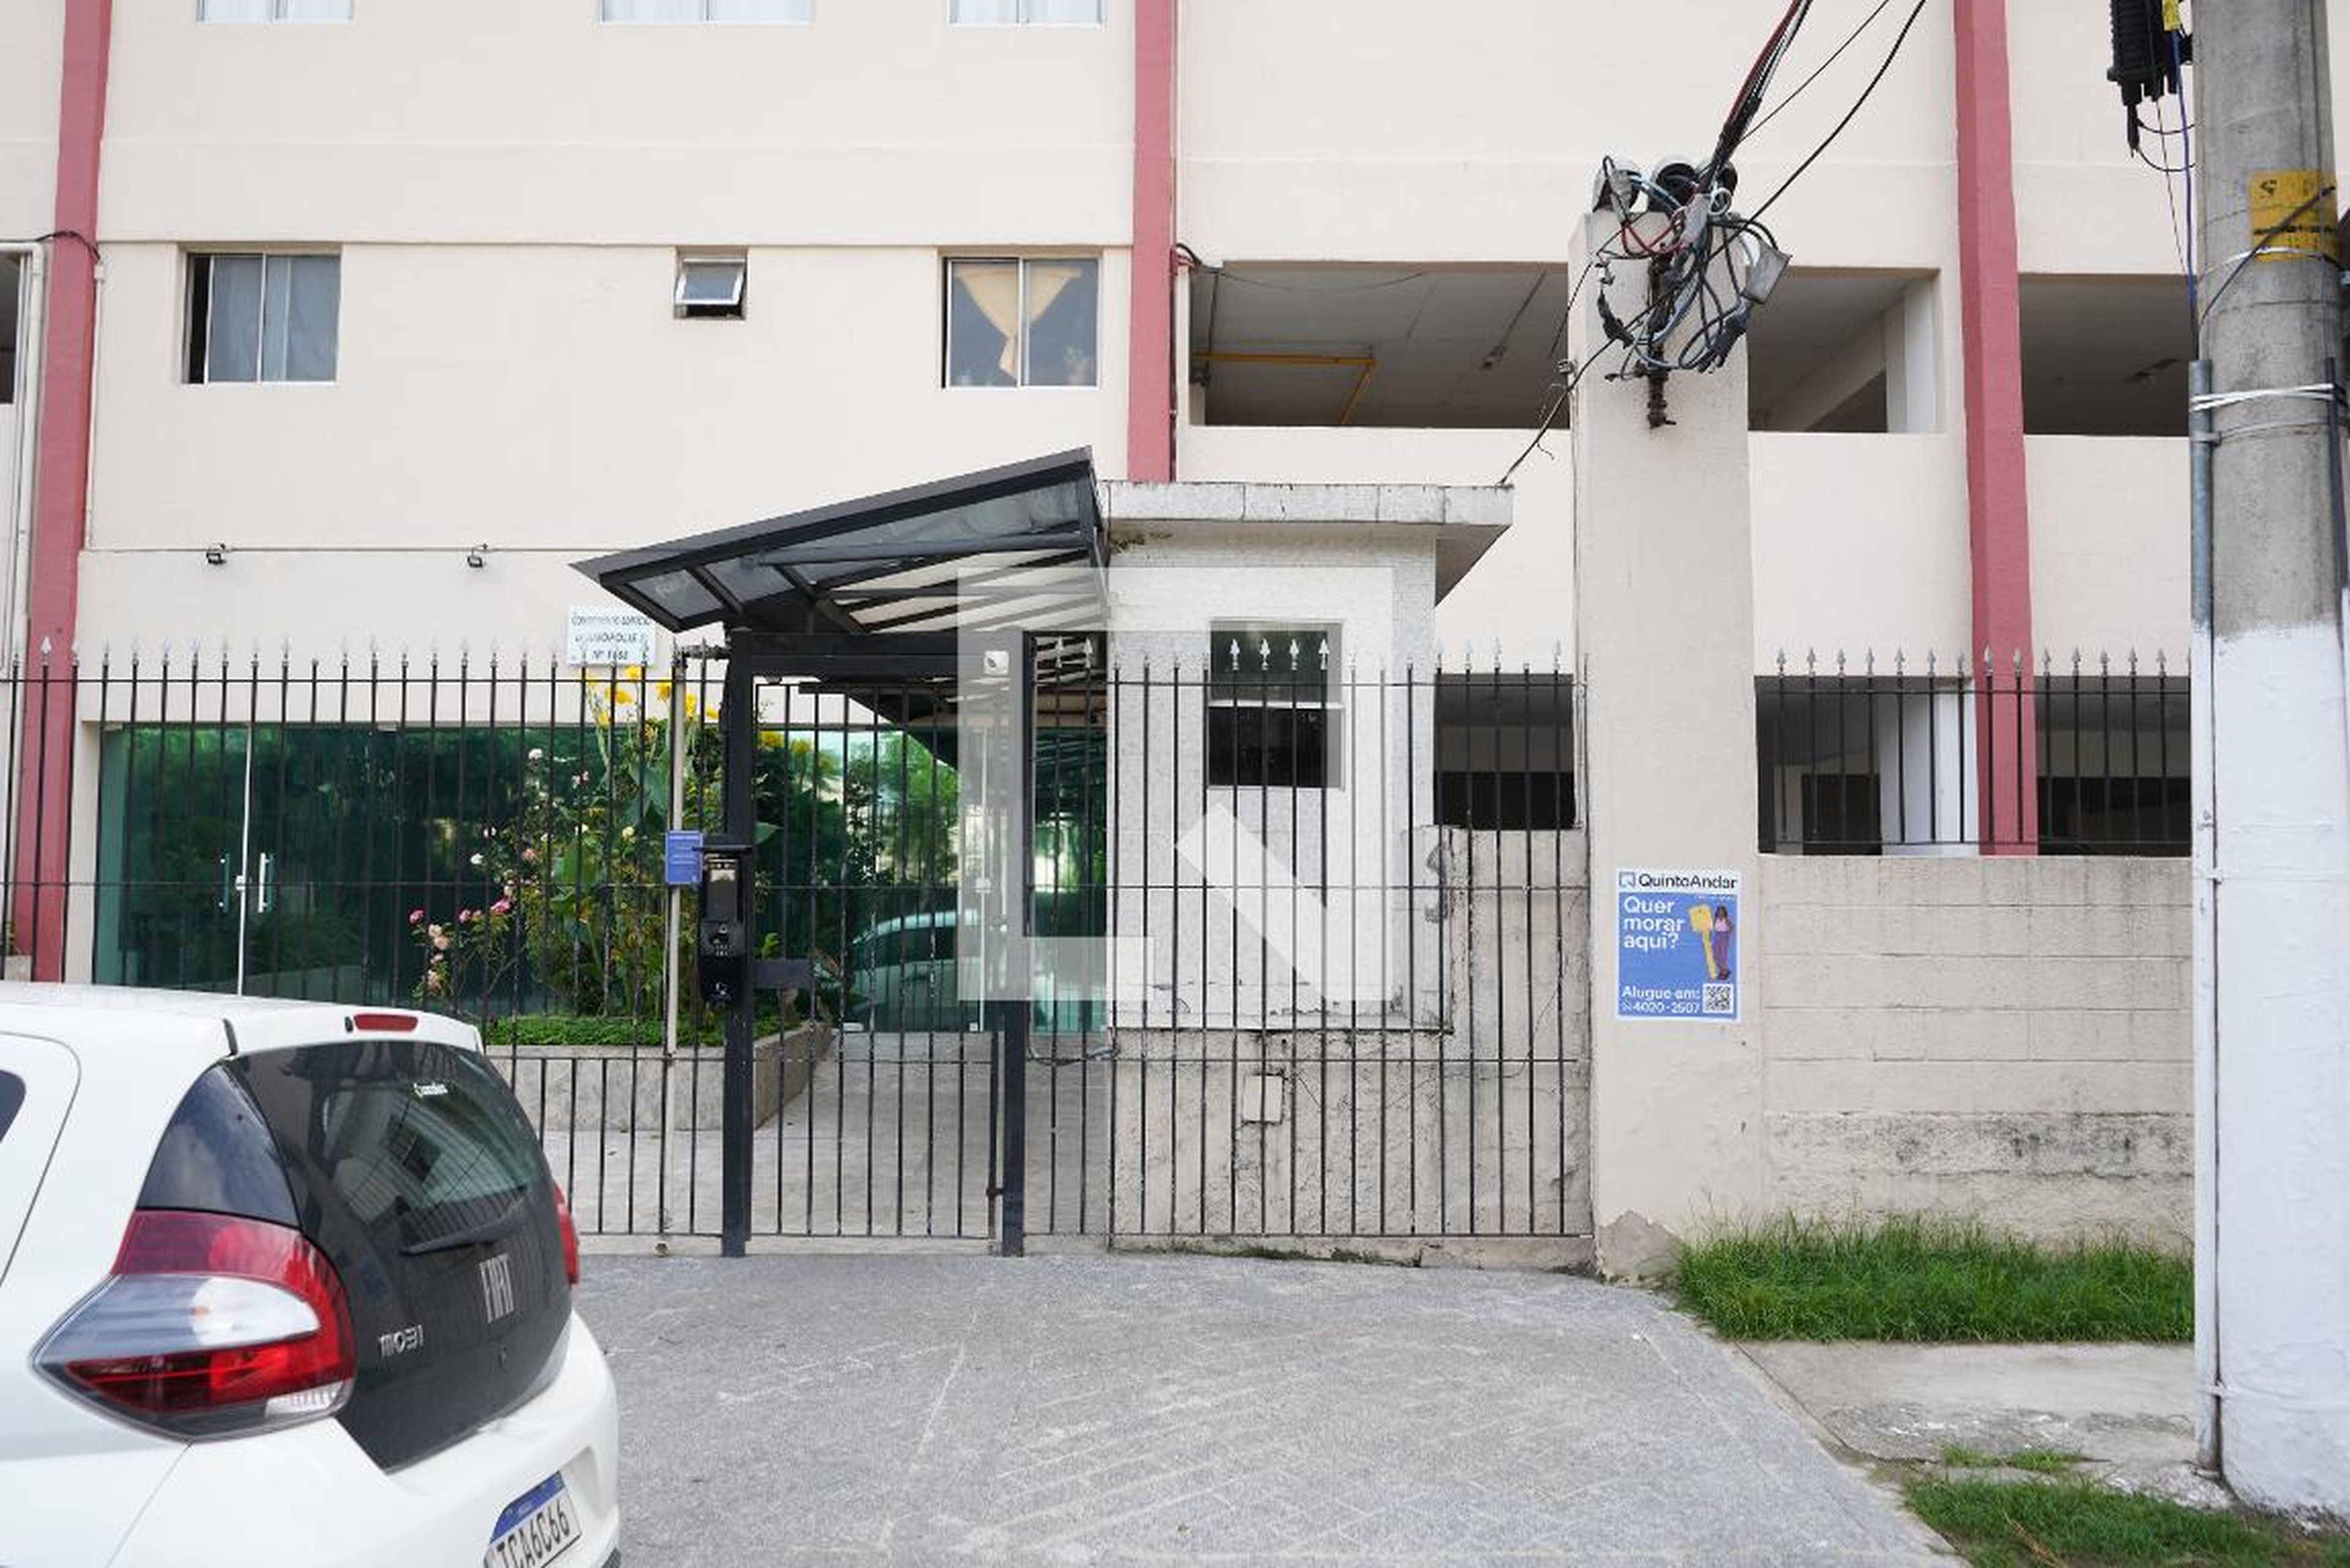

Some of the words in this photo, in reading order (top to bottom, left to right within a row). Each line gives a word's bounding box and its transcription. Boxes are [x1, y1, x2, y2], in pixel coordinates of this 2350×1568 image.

[1638, 873, 1738, 889] QuintoAndar
[1624, 896, 1676, 913] Quer
[1624, 917, 1685, 932] morar
[1624, 932, 1679, 952] aqui?
[1622, 986, 1671, 1001] Alugue
[1674, 989, 1700, 999] em:
[479, 1253, 514, 1324] FIAT
